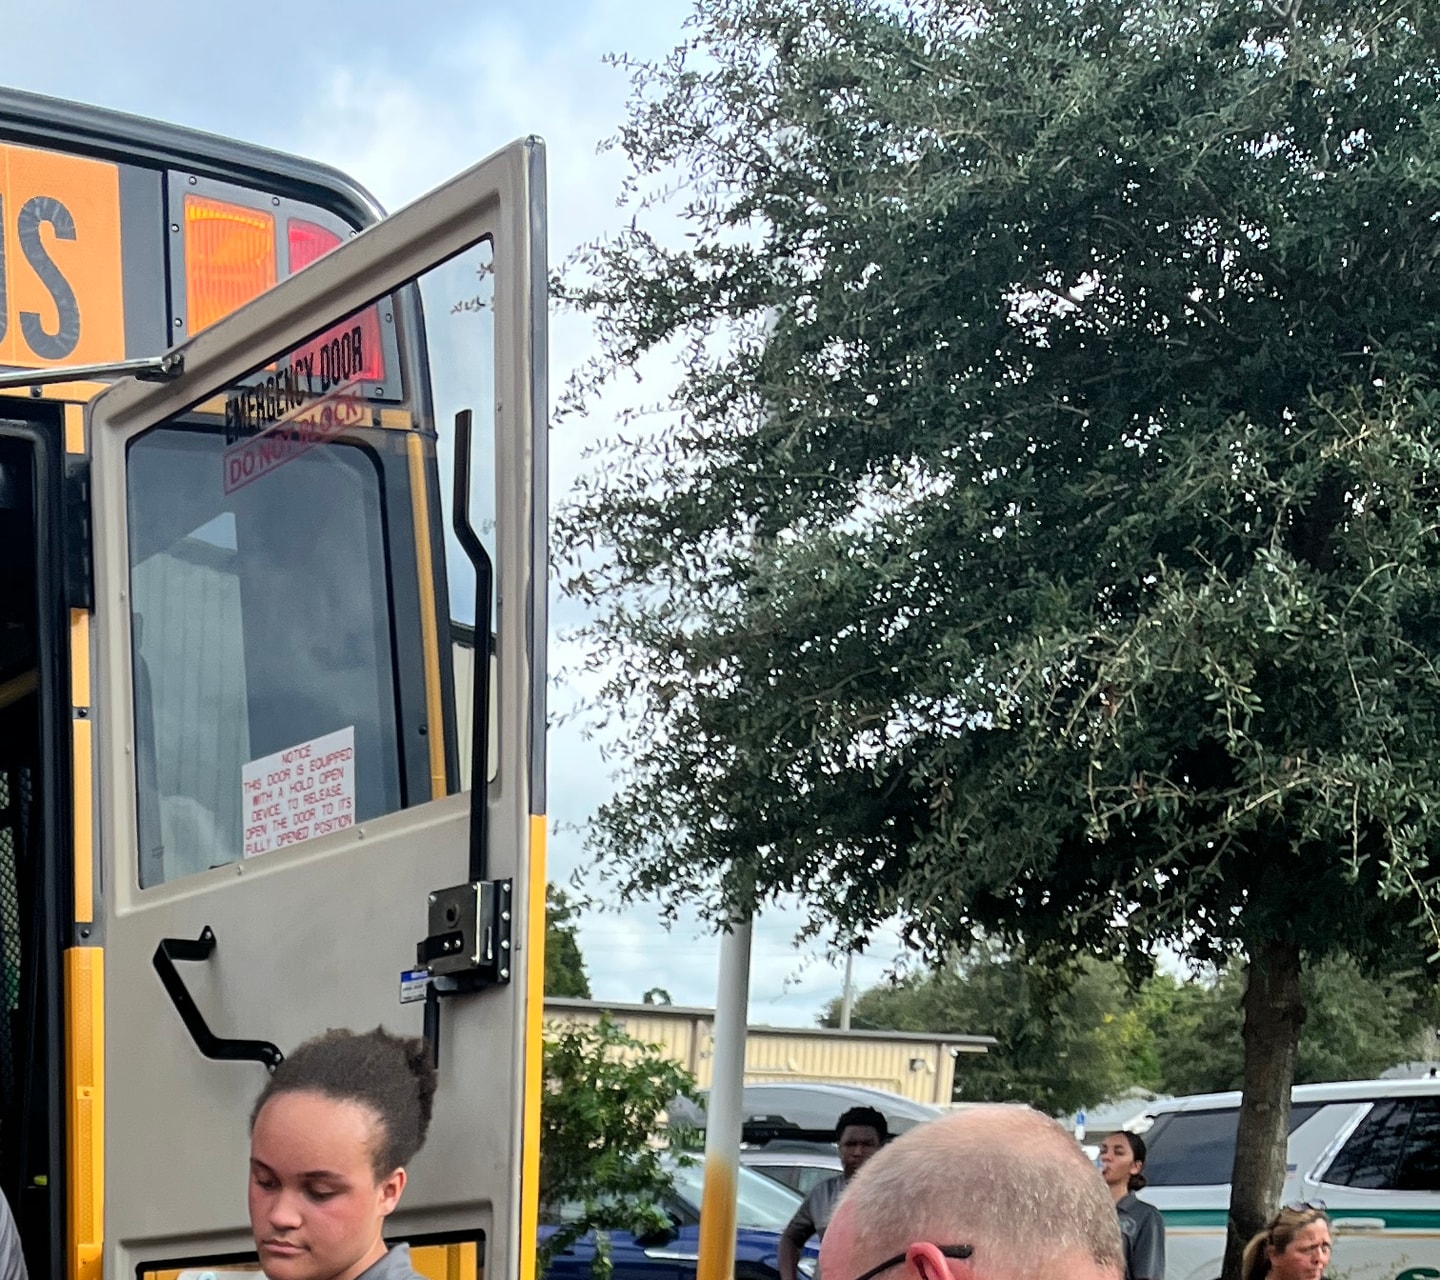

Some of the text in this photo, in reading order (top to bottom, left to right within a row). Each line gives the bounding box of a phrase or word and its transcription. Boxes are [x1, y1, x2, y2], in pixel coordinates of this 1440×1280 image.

[225, 326, 362, 445] EMERGENCY DOOR
[230, 391, 358, 484] DO NOT BLOCK
[244, 747, 352, 792] THIS DOOR IS EQUIPPED
[282, 745, 311, 763] NOTICE
[252, 791, 272, 806] WITH
[289, 777, 313, 792] HOLD
[319, 767, 344, 785] OPEN
[287, 797, 299, 811] TO
[245, 796, 352, 840] OPEN THE DOOR TO ITS
[245, 814, 351, 855] FULLY OPENED POSITION
